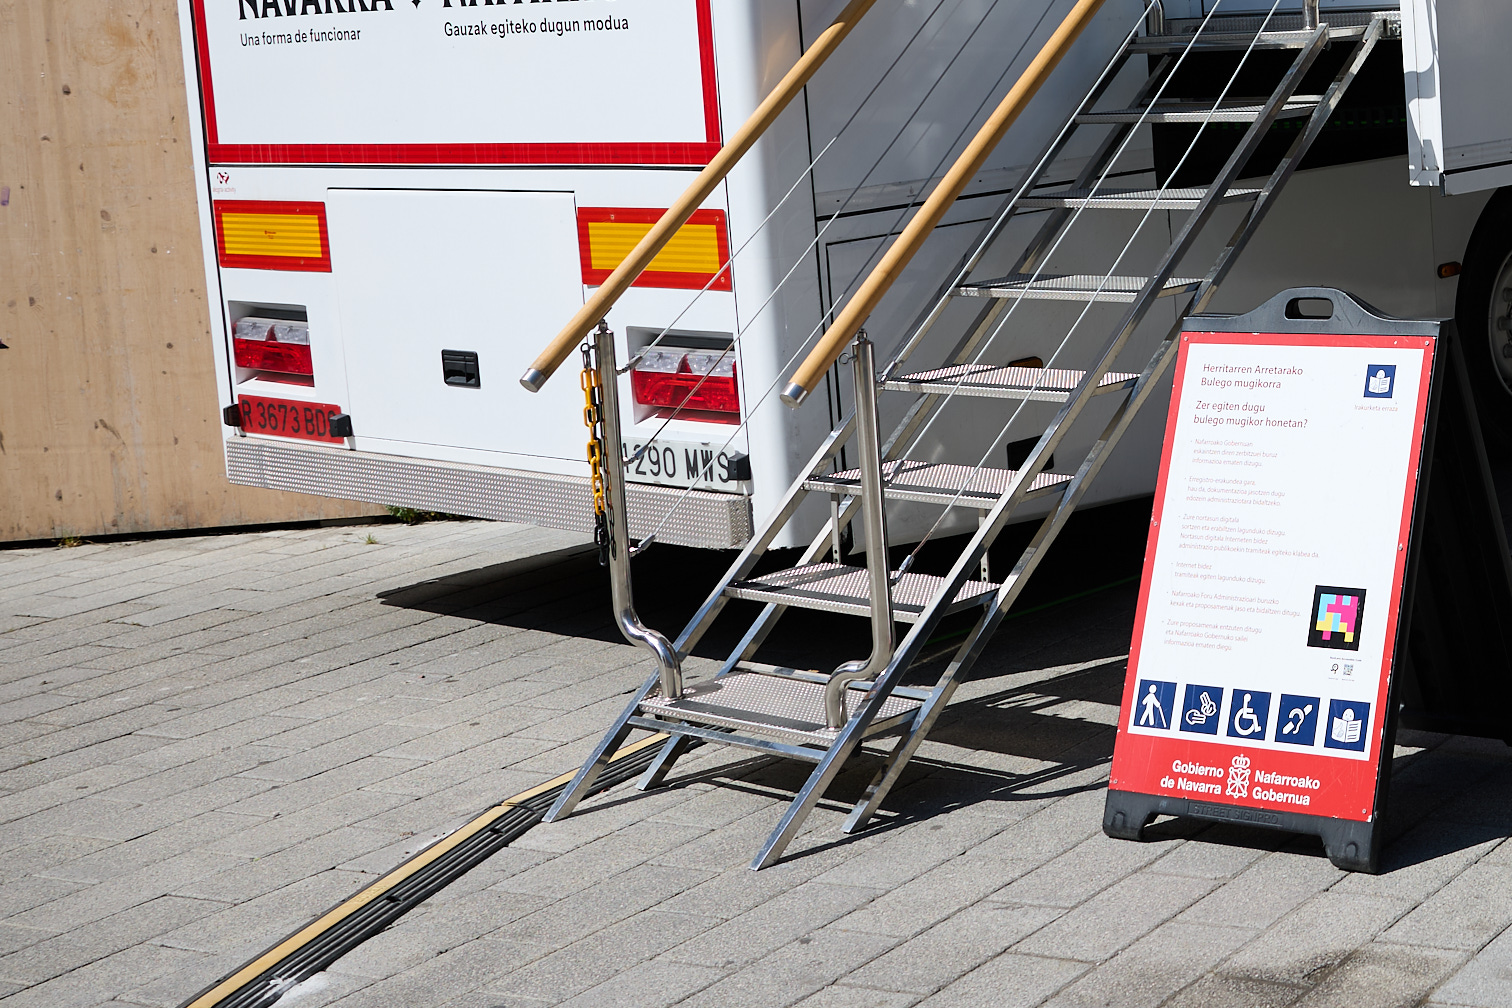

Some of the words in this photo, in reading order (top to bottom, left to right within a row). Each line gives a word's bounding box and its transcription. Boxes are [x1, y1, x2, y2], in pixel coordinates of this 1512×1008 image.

[443, 20, 488, 38] Gauzak
[489, 18, 538, 40] egiteko
[538, 17, 581, 38] dugun
[582, 14, 630, 32] modua
[239, 33, 261, 48] Una
[261, 30, 293, 46] forma
[293, 29, 308, 44] de
[308, 26, 362, 43] funcionar
[1203, 363, 1252, 374] Herritarren
[1255, 364, 1303, 375] Arretarako
[1201, 376, 1232, 389] Bulego
[1235, 378, 1281, 390] mugikorra
[1196, 399, 1210, 410] Zer
[1212, 402, 1240, 412] egiten
[1242, 401, 1265, 414] dugu
[241, 400, 253, 427] R
[257, 402, 300, 433] 3673
[1194, 413, 1224, 427] bulego
[1226, 416, 1264, 428] mugikor
[1266, 416, 1308, 428] honetan?
[685, 448, 730, 483] MWS
[1172, 760, 1224, 778] Gobierno
[1161, 776, 1175, 790] de
[1177, 777, 1222, 795] Navarra
[1254, 769, 1321, 791] Nafarroako
[1252, 787, 1311, 806] Gobernua
[1194, 805, 1231, 817] STREET
[1234, 809, 1278, 824] SIGNPRO
